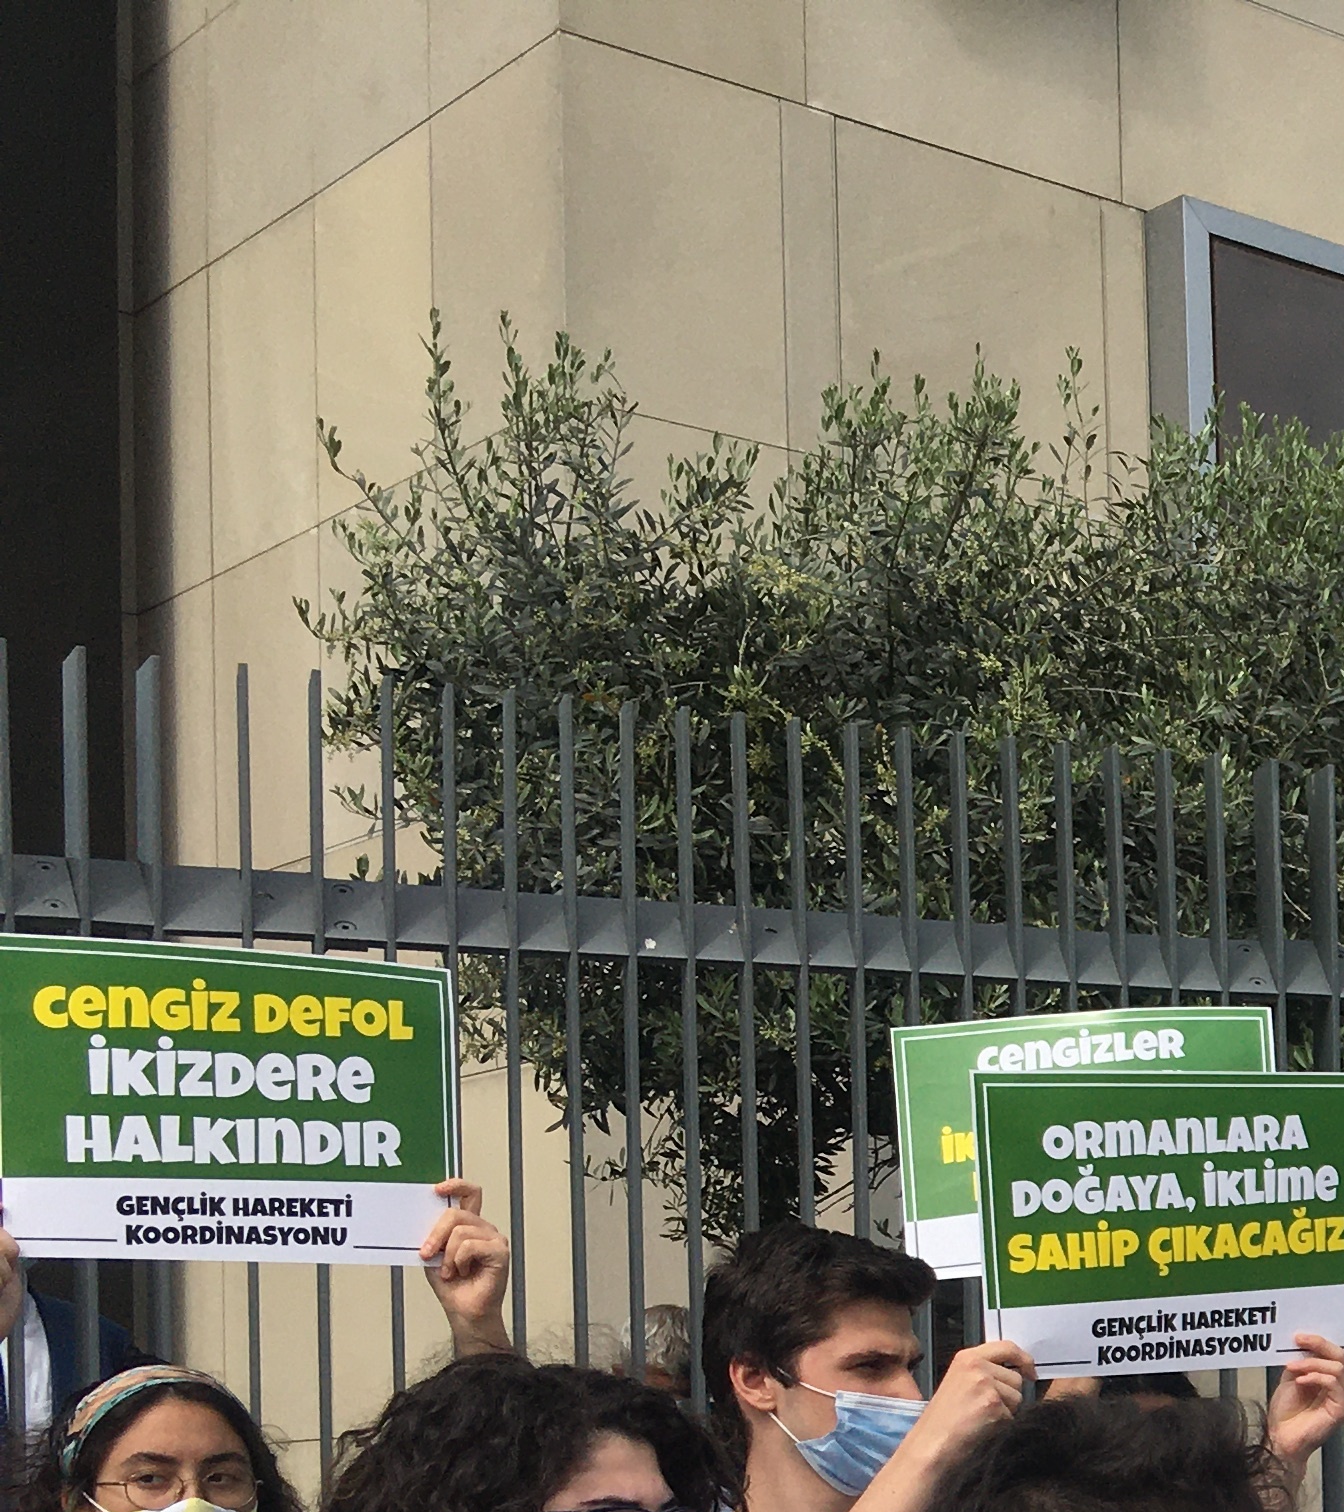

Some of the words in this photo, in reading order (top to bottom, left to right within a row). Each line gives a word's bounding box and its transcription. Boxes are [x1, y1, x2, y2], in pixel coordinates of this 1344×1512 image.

[116, 1191, 226, 1221] GENÇLİK
[232, 1194, 353, 1218] HAREKETİ
[1011, 1164, 1196, 1218] DOĞAYA,
[125, 1220, 348, 1247] KOORDİNASYONU
[1008, 1220, 1140, 1274] SAHİP
[1092, 1309, 1177, 1340] GENÇLİK
[1182, 1301, 1277, 1331] HAREKETİ
[1097, 1333, 1272, 1366] KOORDİNASYONU
